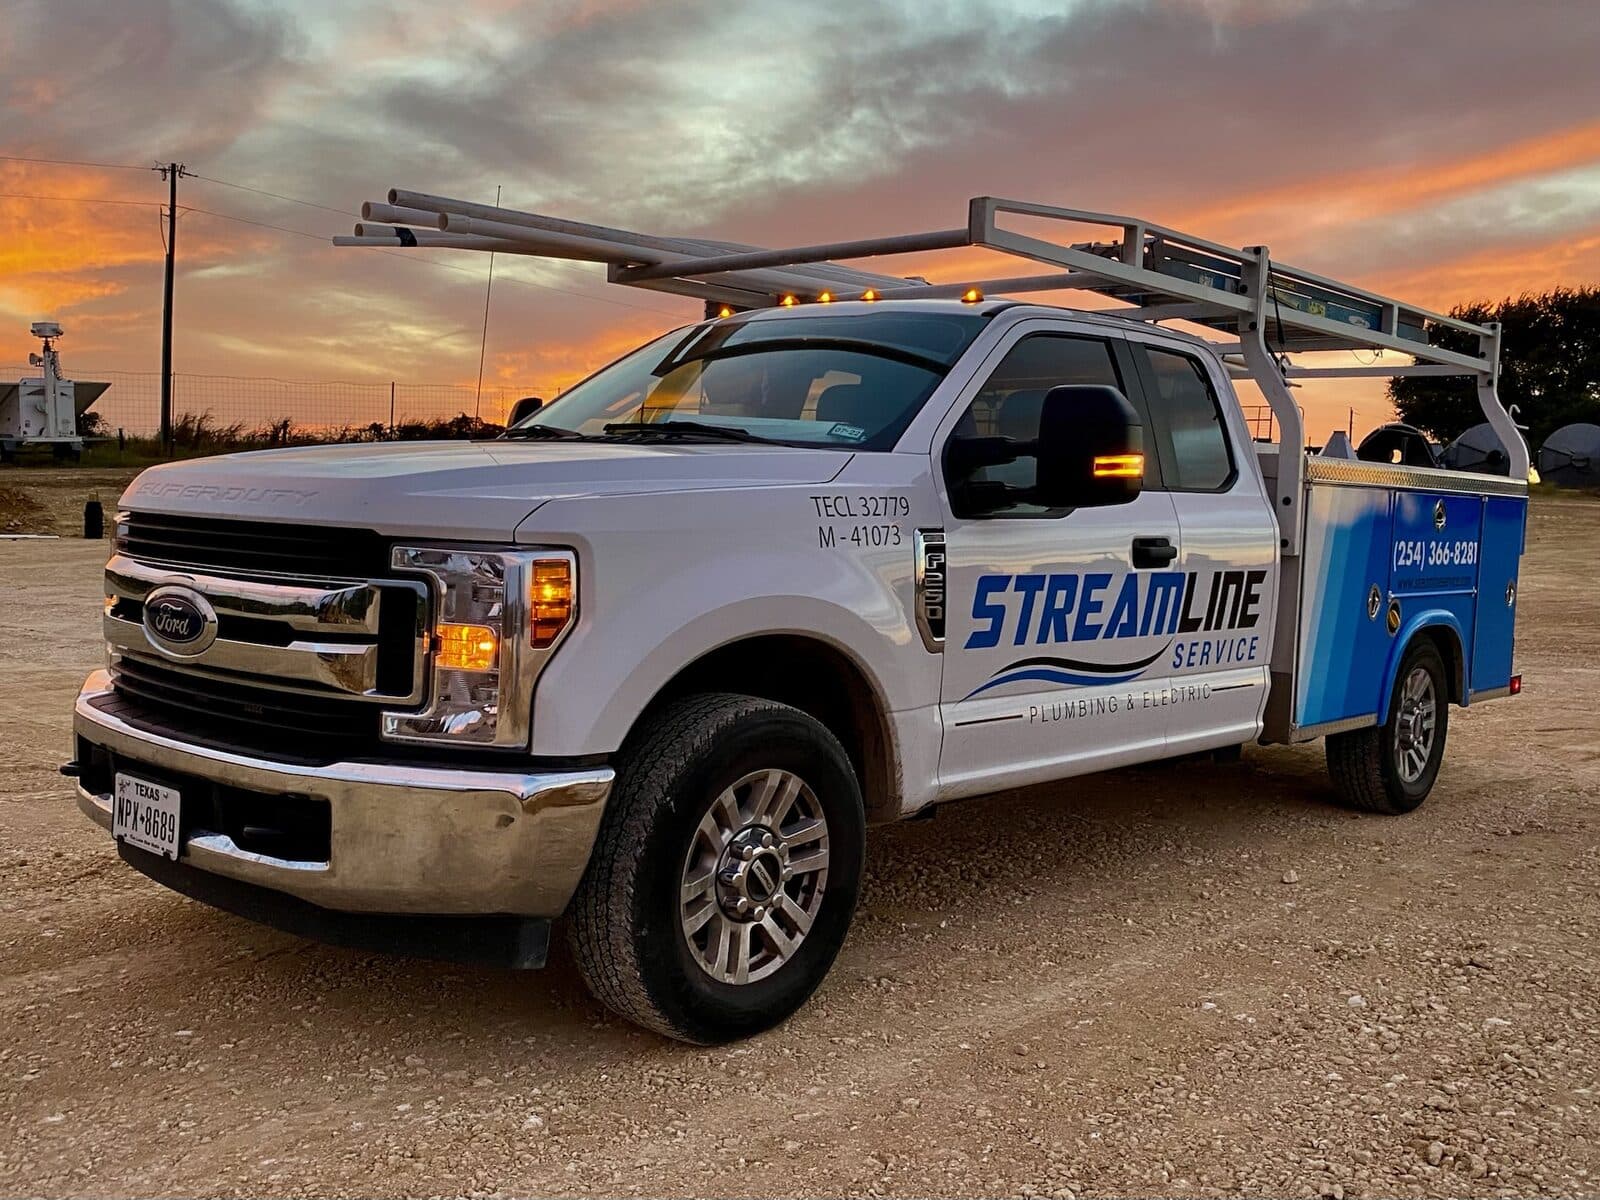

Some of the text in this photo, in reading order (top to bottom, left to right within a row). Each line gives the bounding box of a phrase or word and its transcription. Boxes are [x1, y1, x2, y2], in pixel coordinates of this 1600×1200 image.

[810, 496, 910, 517] TECL 32779
[818, 526, 836, 548] M
[851, 525, 901, 547] 41073
[1393, 541, 1478, 572] (254) 366-8281
[155, 603, 190, 635] Ford
[963, 570, 1267, 649] STREAMLINE
[1172, 636, 1259, 669] SERVICE
[1029, 683, 1212, 724] PLUMBING & ELECTRIC
[135, 782, 160, 801] TEXAS
